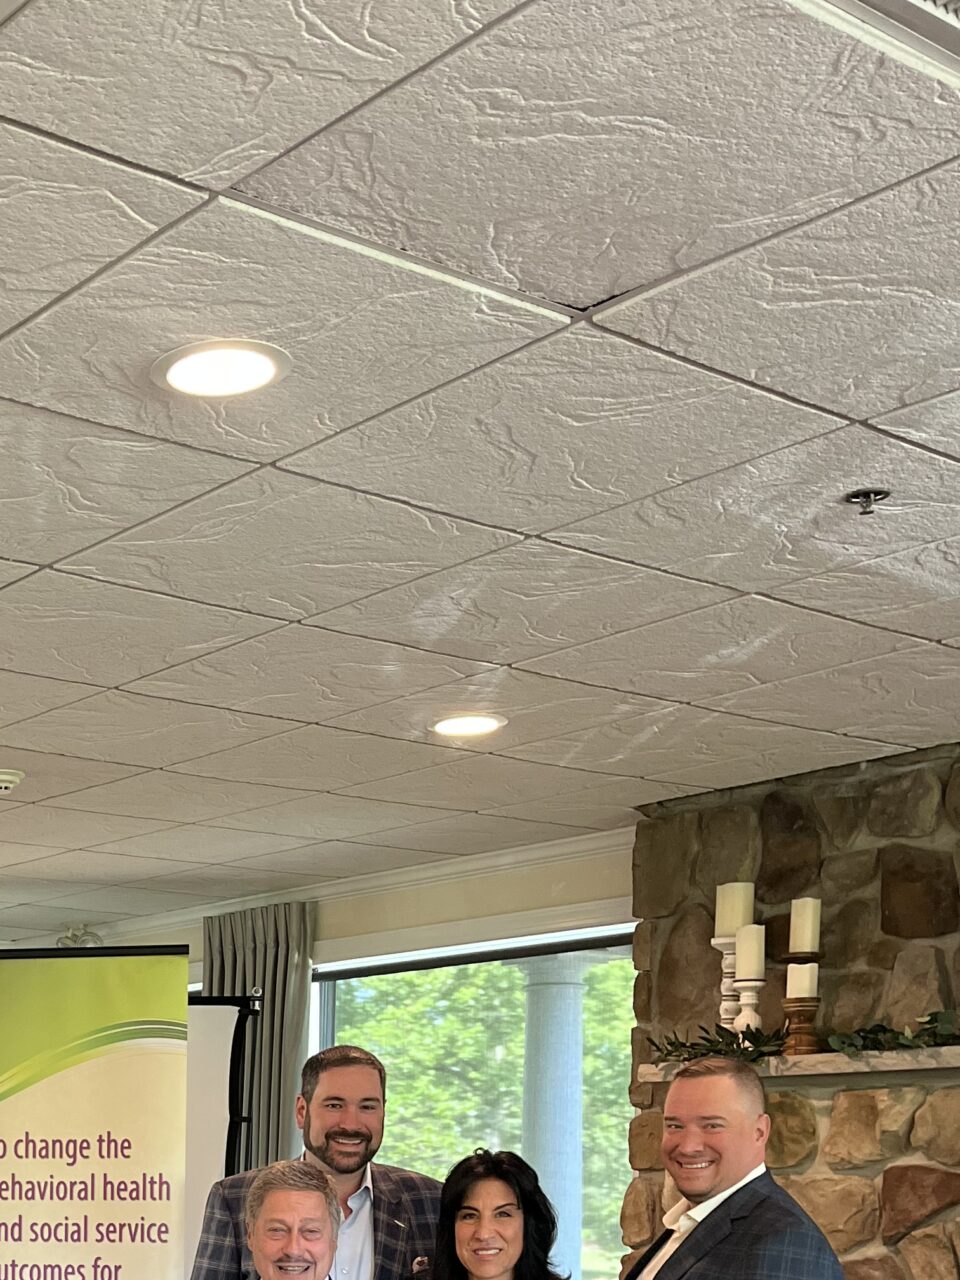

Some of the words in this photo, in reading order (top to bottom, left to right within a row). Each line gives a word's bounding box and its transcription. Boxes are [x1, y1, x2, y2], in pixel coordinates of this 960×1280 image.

[14, 1131, 90, 1166] change
[97, 1131, 132, 1159] the
[103, 1173, 171, 1201] health
[29, 1215, 88, 1243] social
[95, 1216, 169, 1243] service
